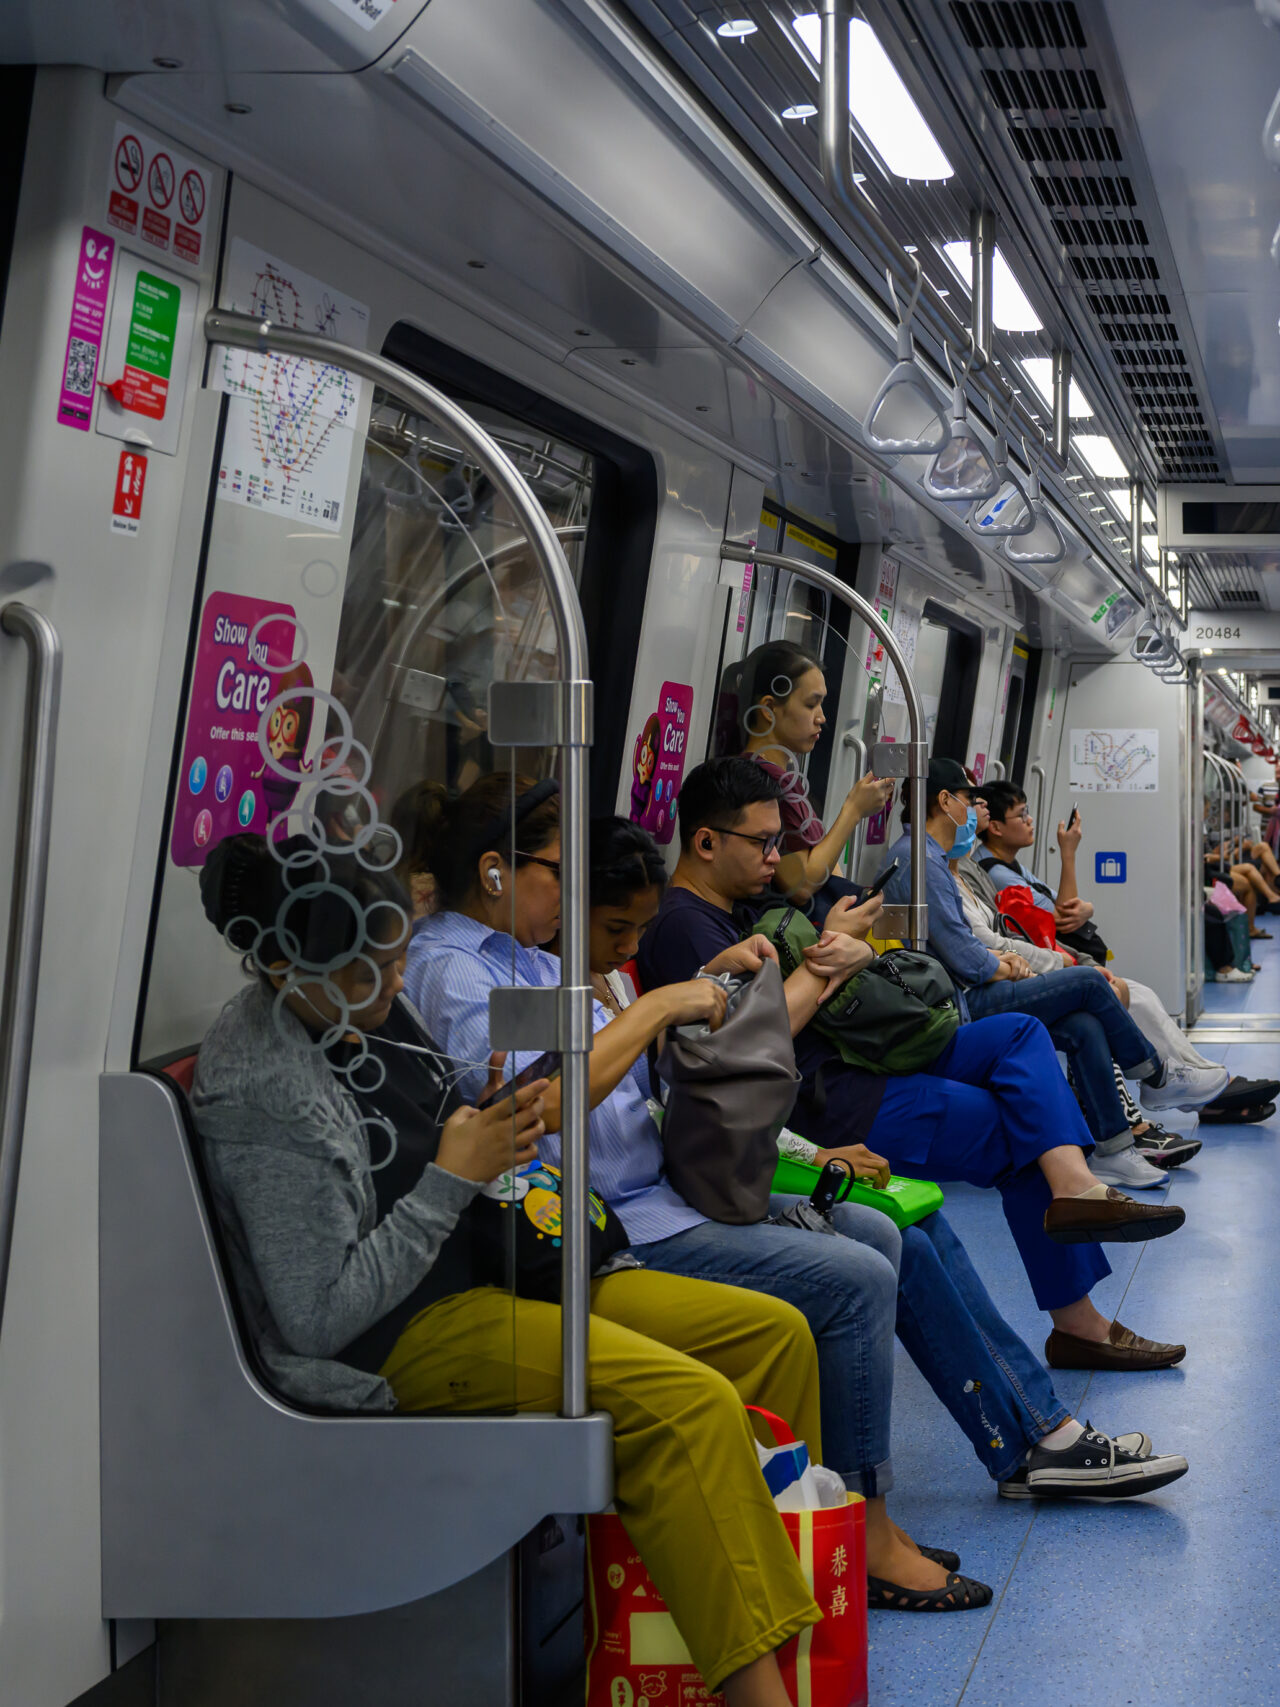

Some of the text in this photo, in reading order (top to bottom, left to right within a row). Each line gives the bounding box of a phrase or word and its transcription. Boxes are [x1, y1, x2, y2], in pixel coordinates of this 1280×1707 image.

[214, 616, 248, 645] Show
[1196, 627, 1241, 639] 20484
[216, 660, 271, 712] Care
[665, 697, 685, 724] Show You
[210, 726, 259, 742] Offer this sea
[663, 722, 685, 753] Care
[829, 1544, 849, 1618] 恭喜
